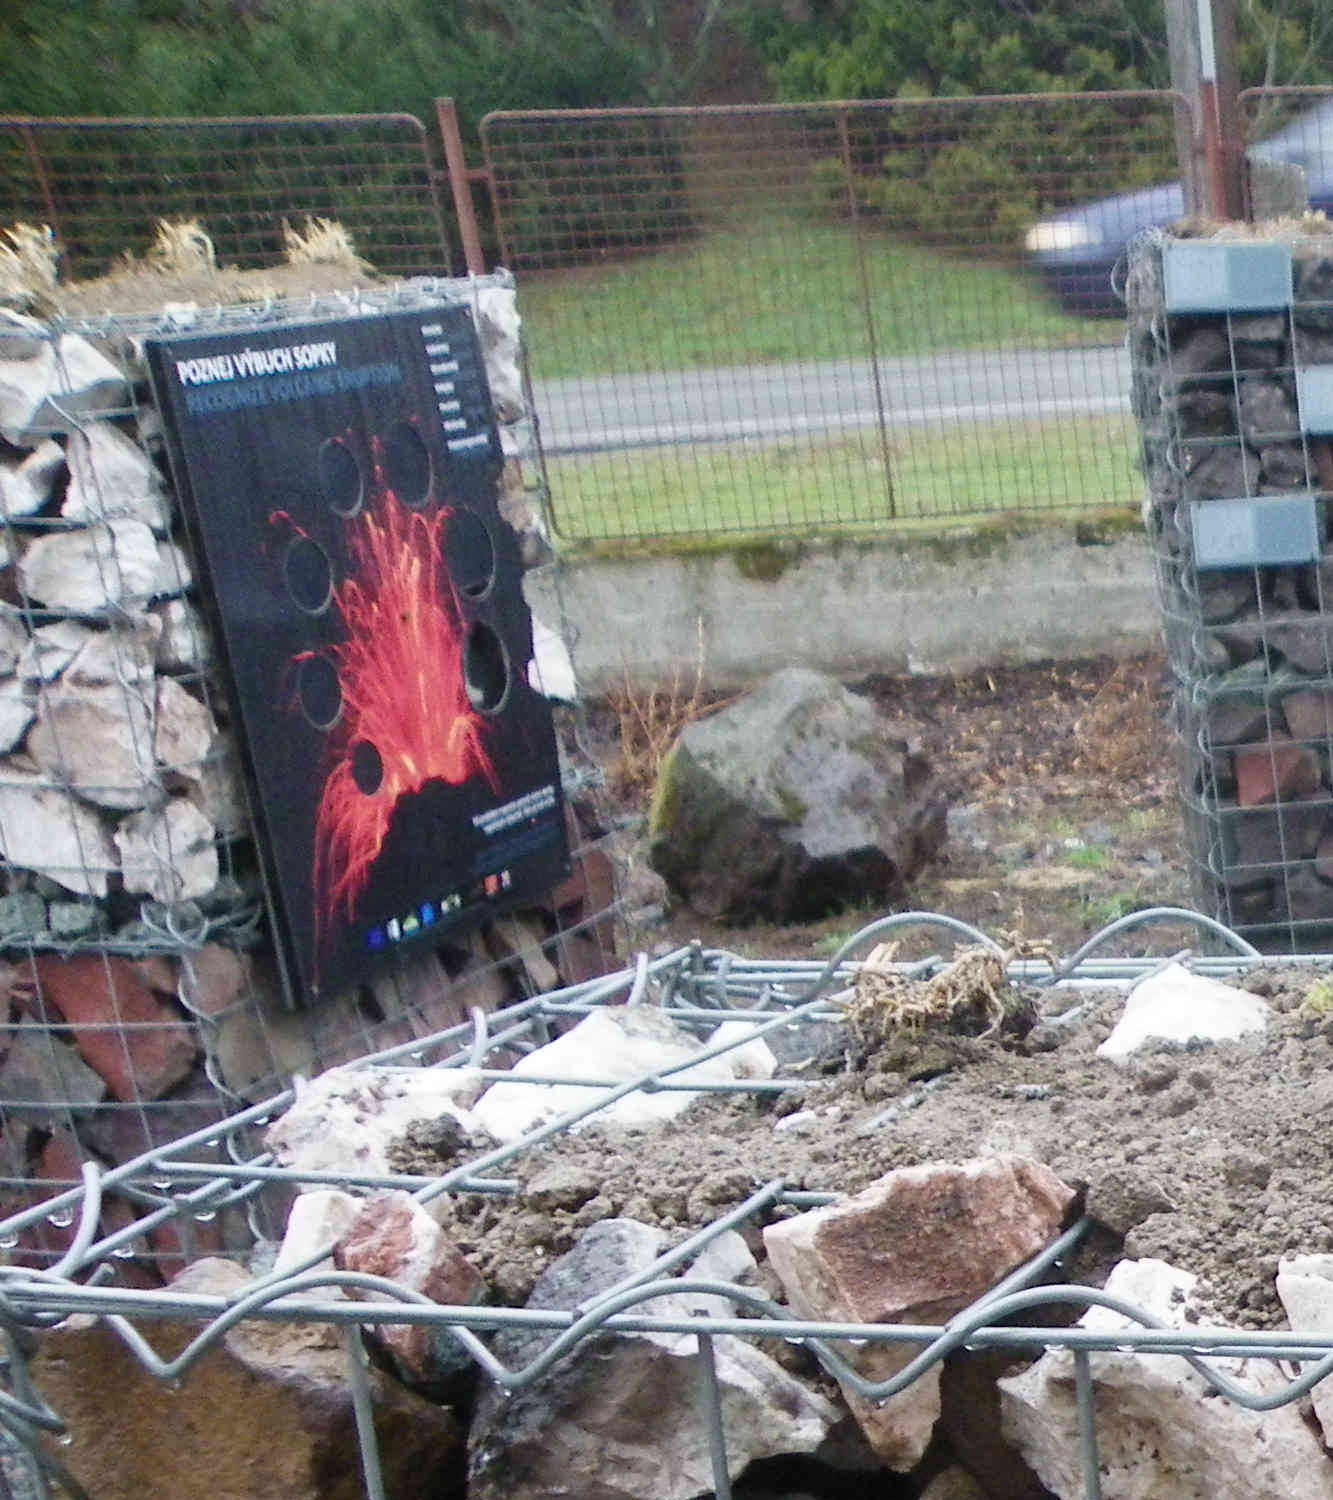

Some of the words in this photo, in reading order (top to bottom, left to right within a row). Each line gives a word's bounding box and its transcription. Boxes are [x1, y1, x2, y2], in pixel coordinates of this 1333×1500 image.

[176, 353, 233, 386] POZNEJ
[232, 347, 294, 378] VÝBUCH
[294, 341, 336, 370] SOPKY
